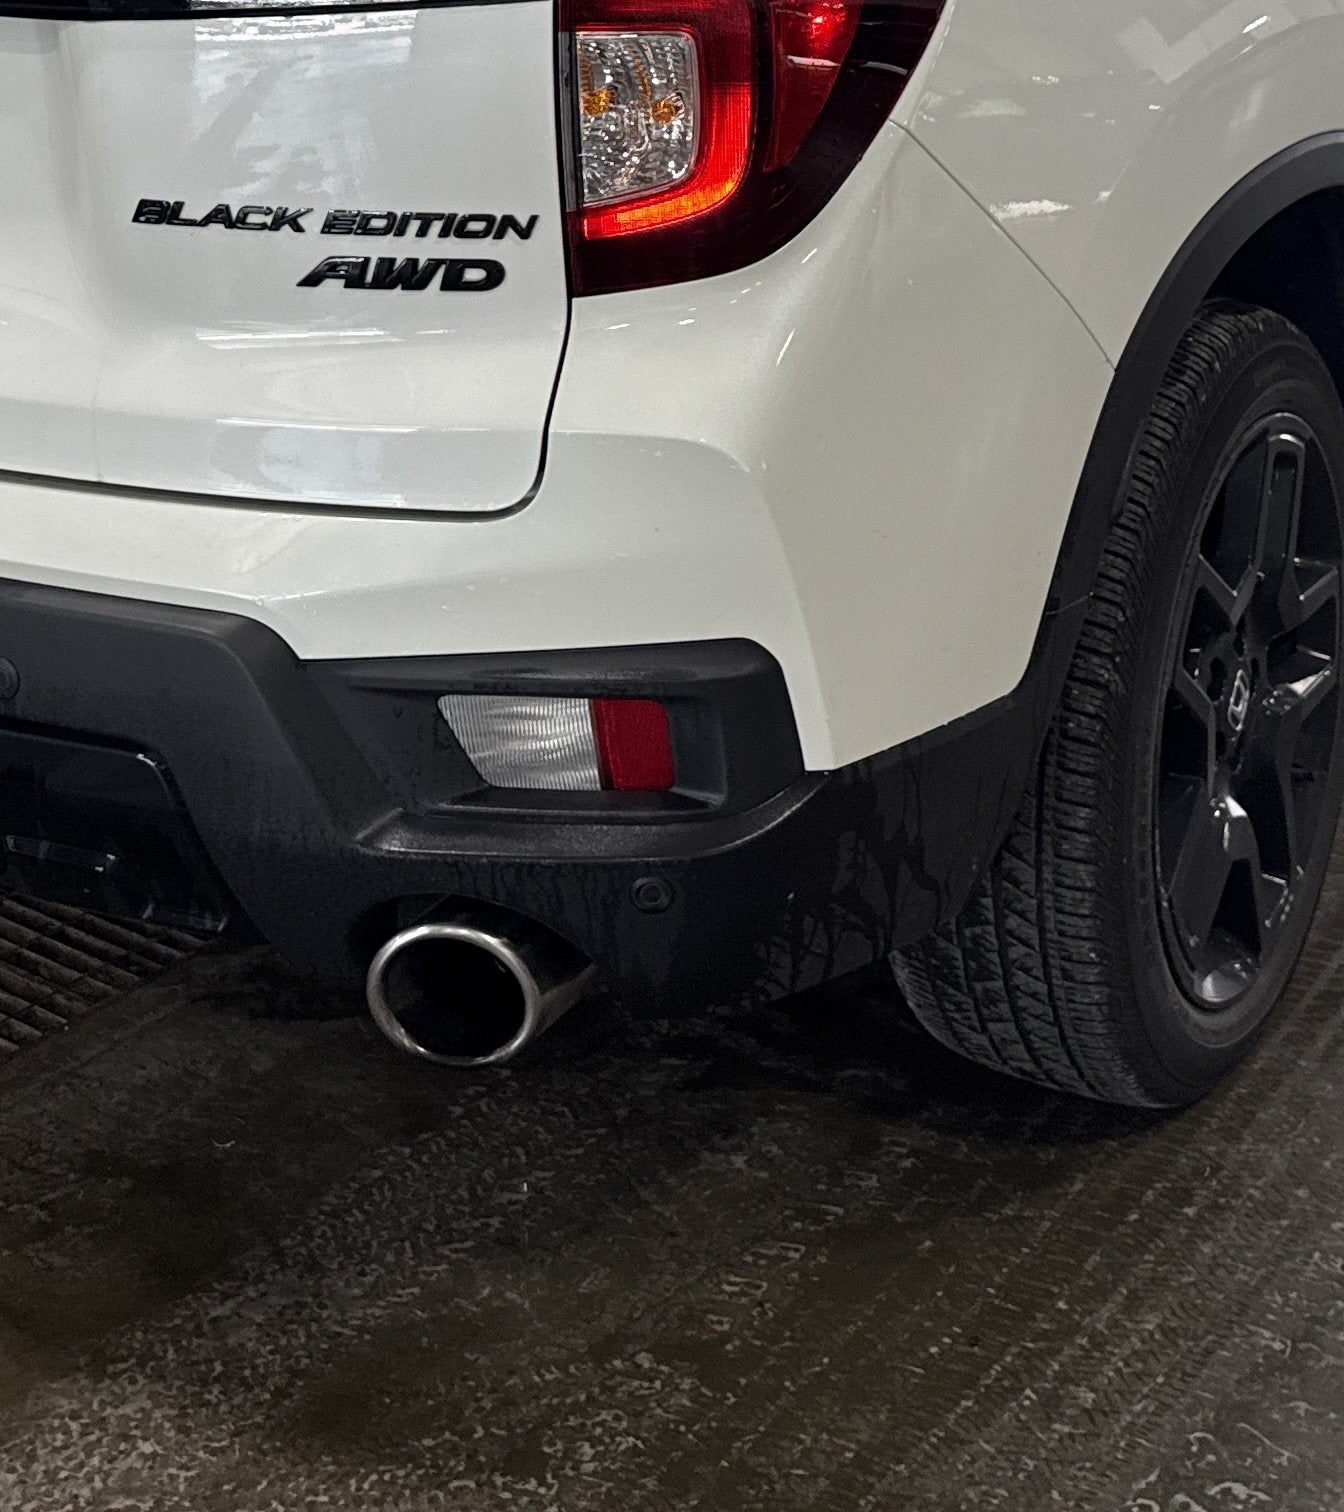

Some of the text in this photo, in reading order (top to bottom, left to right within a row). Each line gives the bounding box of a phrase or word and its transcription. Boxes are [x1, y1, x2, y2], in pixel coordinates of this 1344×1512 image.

[132, 198, 539, 240] BLACK EDITION
[296, 255, 506, 291] AWD
